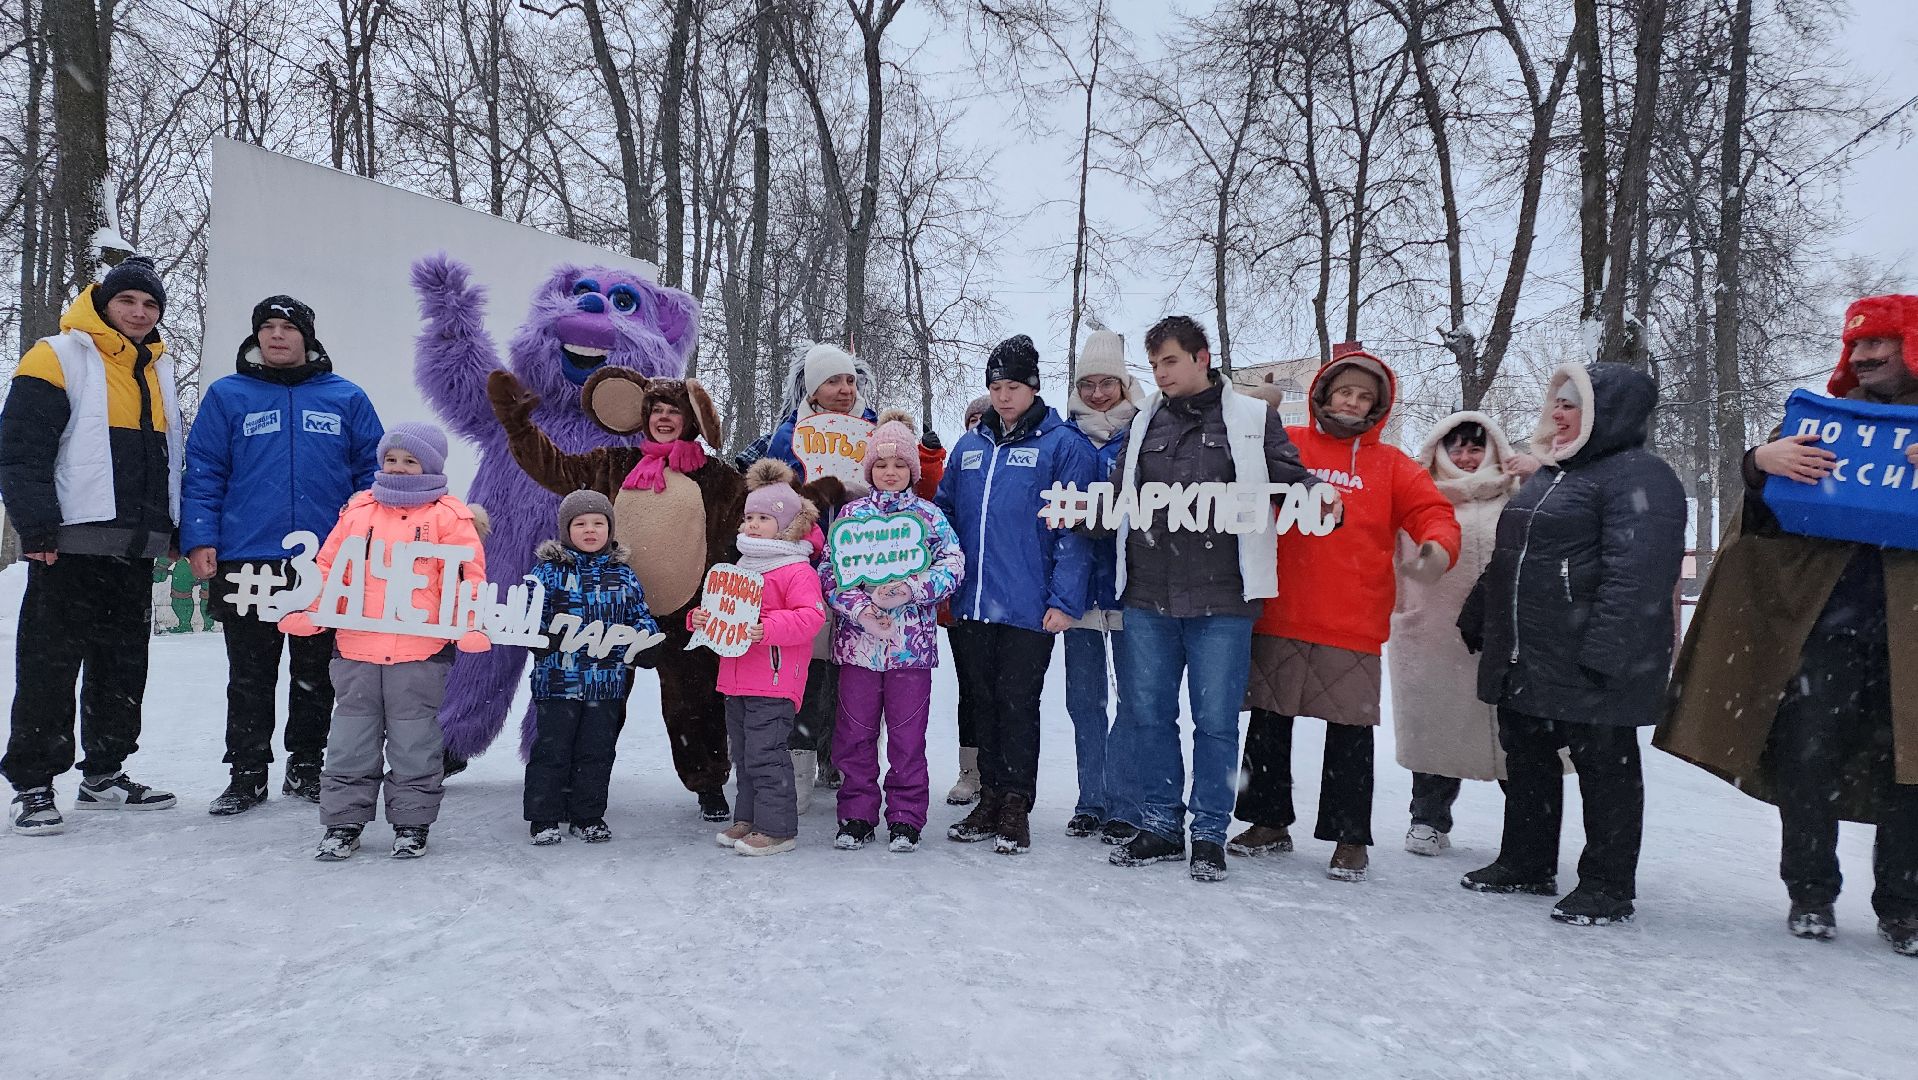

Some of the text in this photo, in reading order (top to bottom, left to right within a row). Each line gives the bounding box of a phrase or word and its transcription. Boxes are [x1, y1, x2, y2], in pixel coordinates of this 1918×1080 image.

[797, 426, 867, 464] ТАТЬЯ
[1796, 418, 1912, 450] ПОЧТ
[1832, 459, 1918, 490] ССИ
[1040, 481, 1336, 536] #ПАРКПЕГАС
[840, 522, 911, 546] ЛУЧШИЙ
[841, 548, 921, 568] СТУДЕНТ
[719, 597, 736, 616] НА
